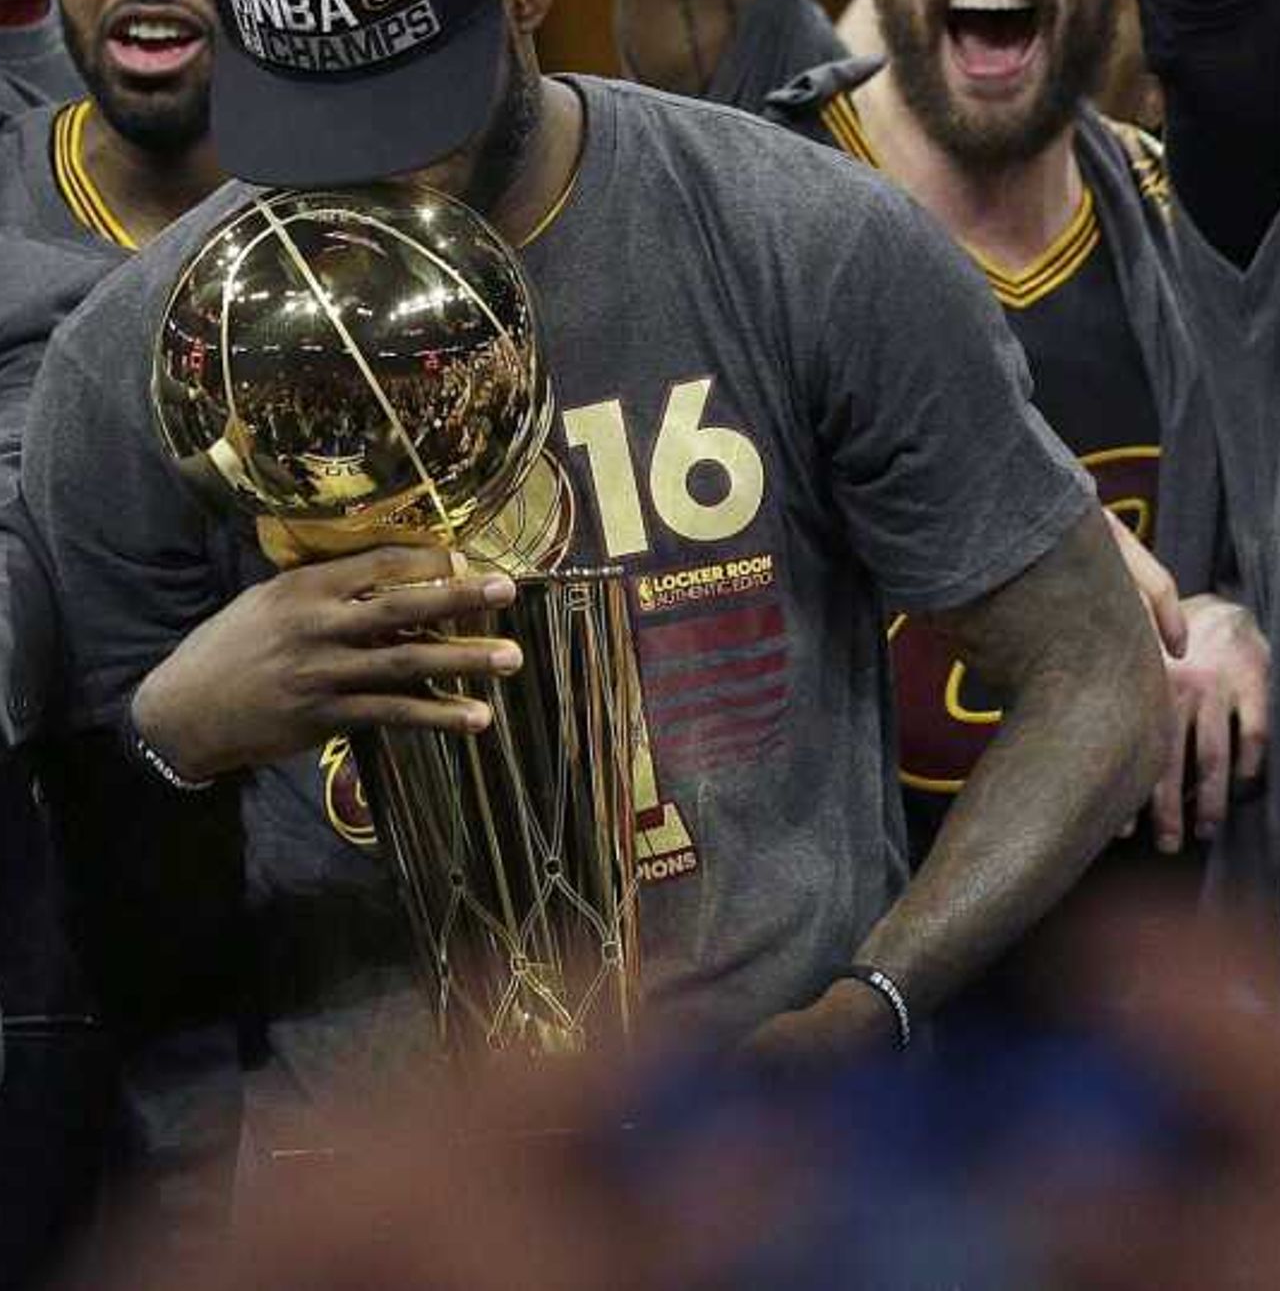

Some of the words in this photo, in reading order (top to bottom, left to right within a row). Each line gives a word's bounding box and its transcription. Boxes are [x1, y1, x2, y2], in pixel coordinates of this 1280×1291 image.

[263, 0, 440, 68] CHAMPS
[563, 378, 765, 558] 16
[654, 565, 725, 592] LOCKER
